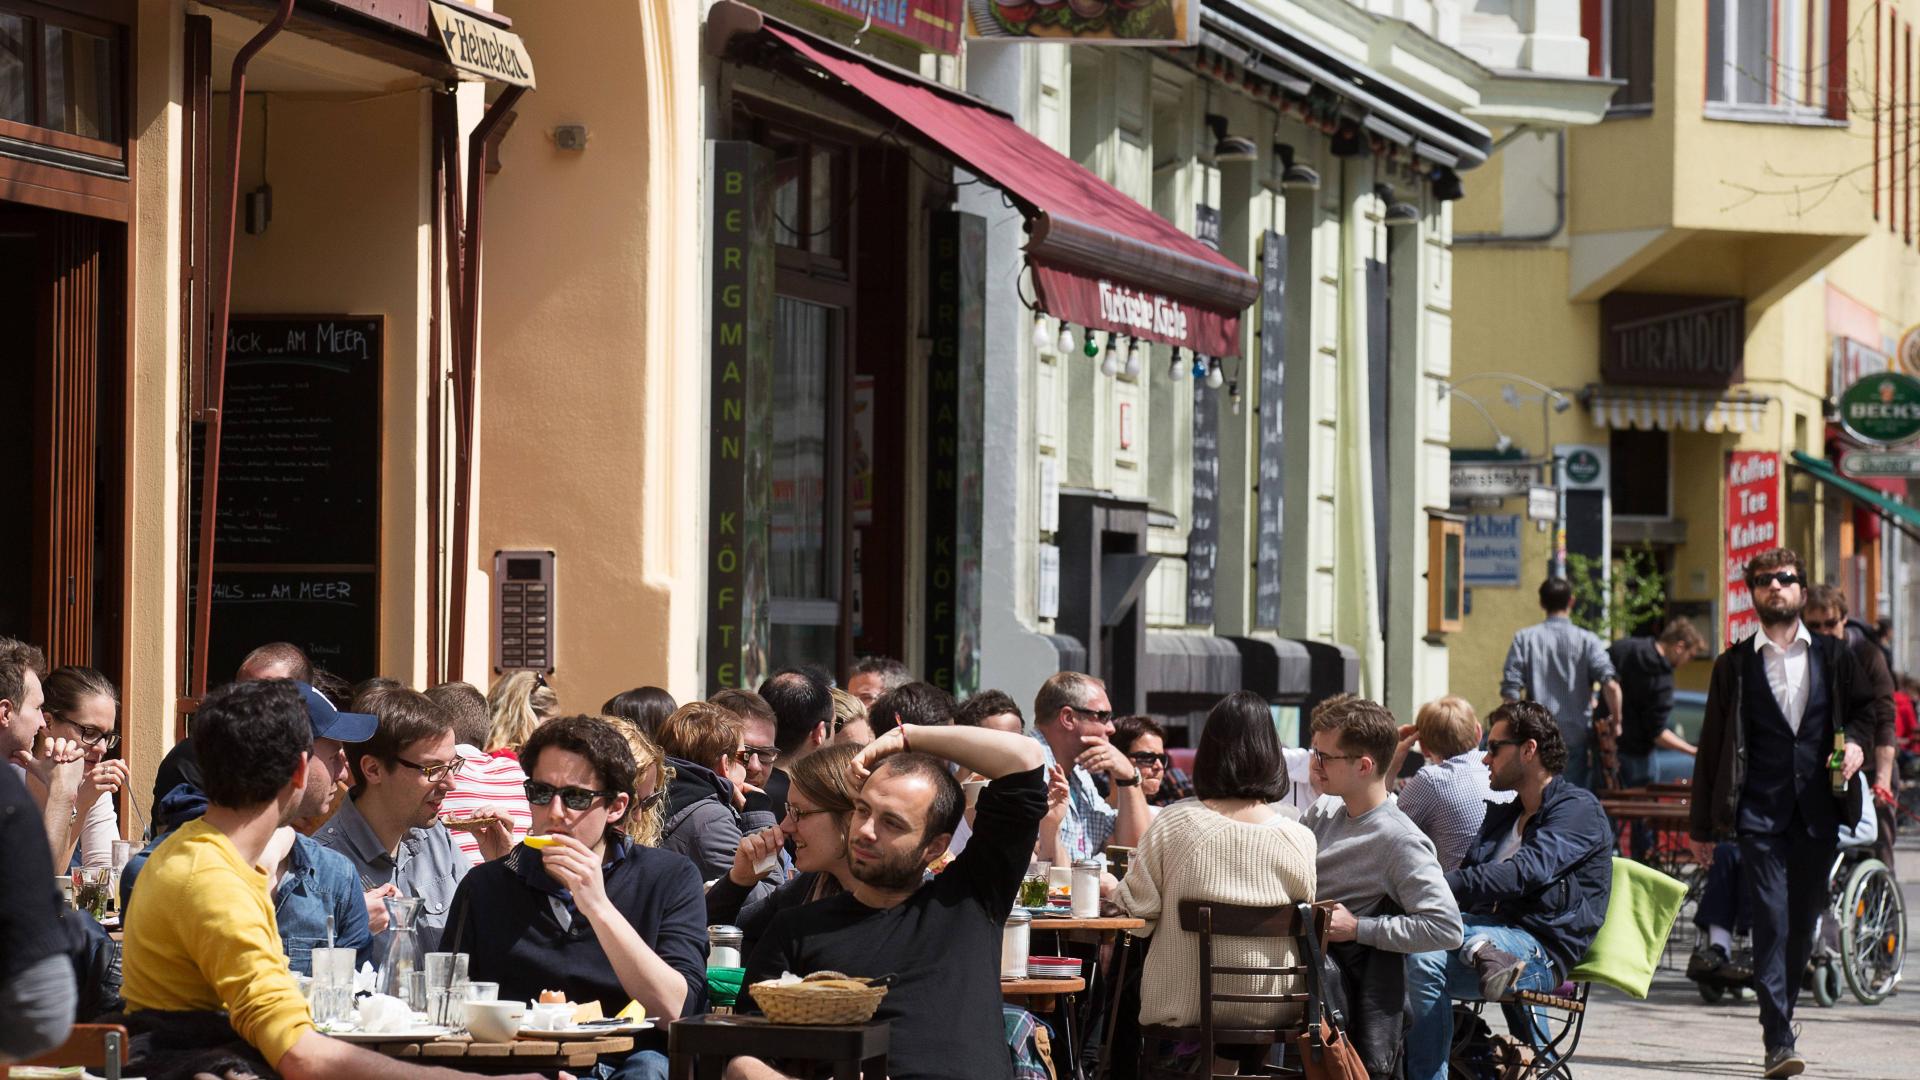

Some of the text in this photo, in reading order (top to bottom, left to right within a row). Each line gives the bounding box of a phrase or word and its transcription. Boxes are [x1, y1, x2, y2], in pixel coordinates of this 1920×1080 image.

[454, 17, 529, 79] Heineken
[287, 329, 306, 353] AM
[717, 171, 743, 687] BERGMANN KÖFTE
[1730, 455, 1776, 487] Kaffee
[1738, 489, 1768, 516] Tee
[270, 583, 291, 600] AM
[299, 581, 351, 600] MEER
